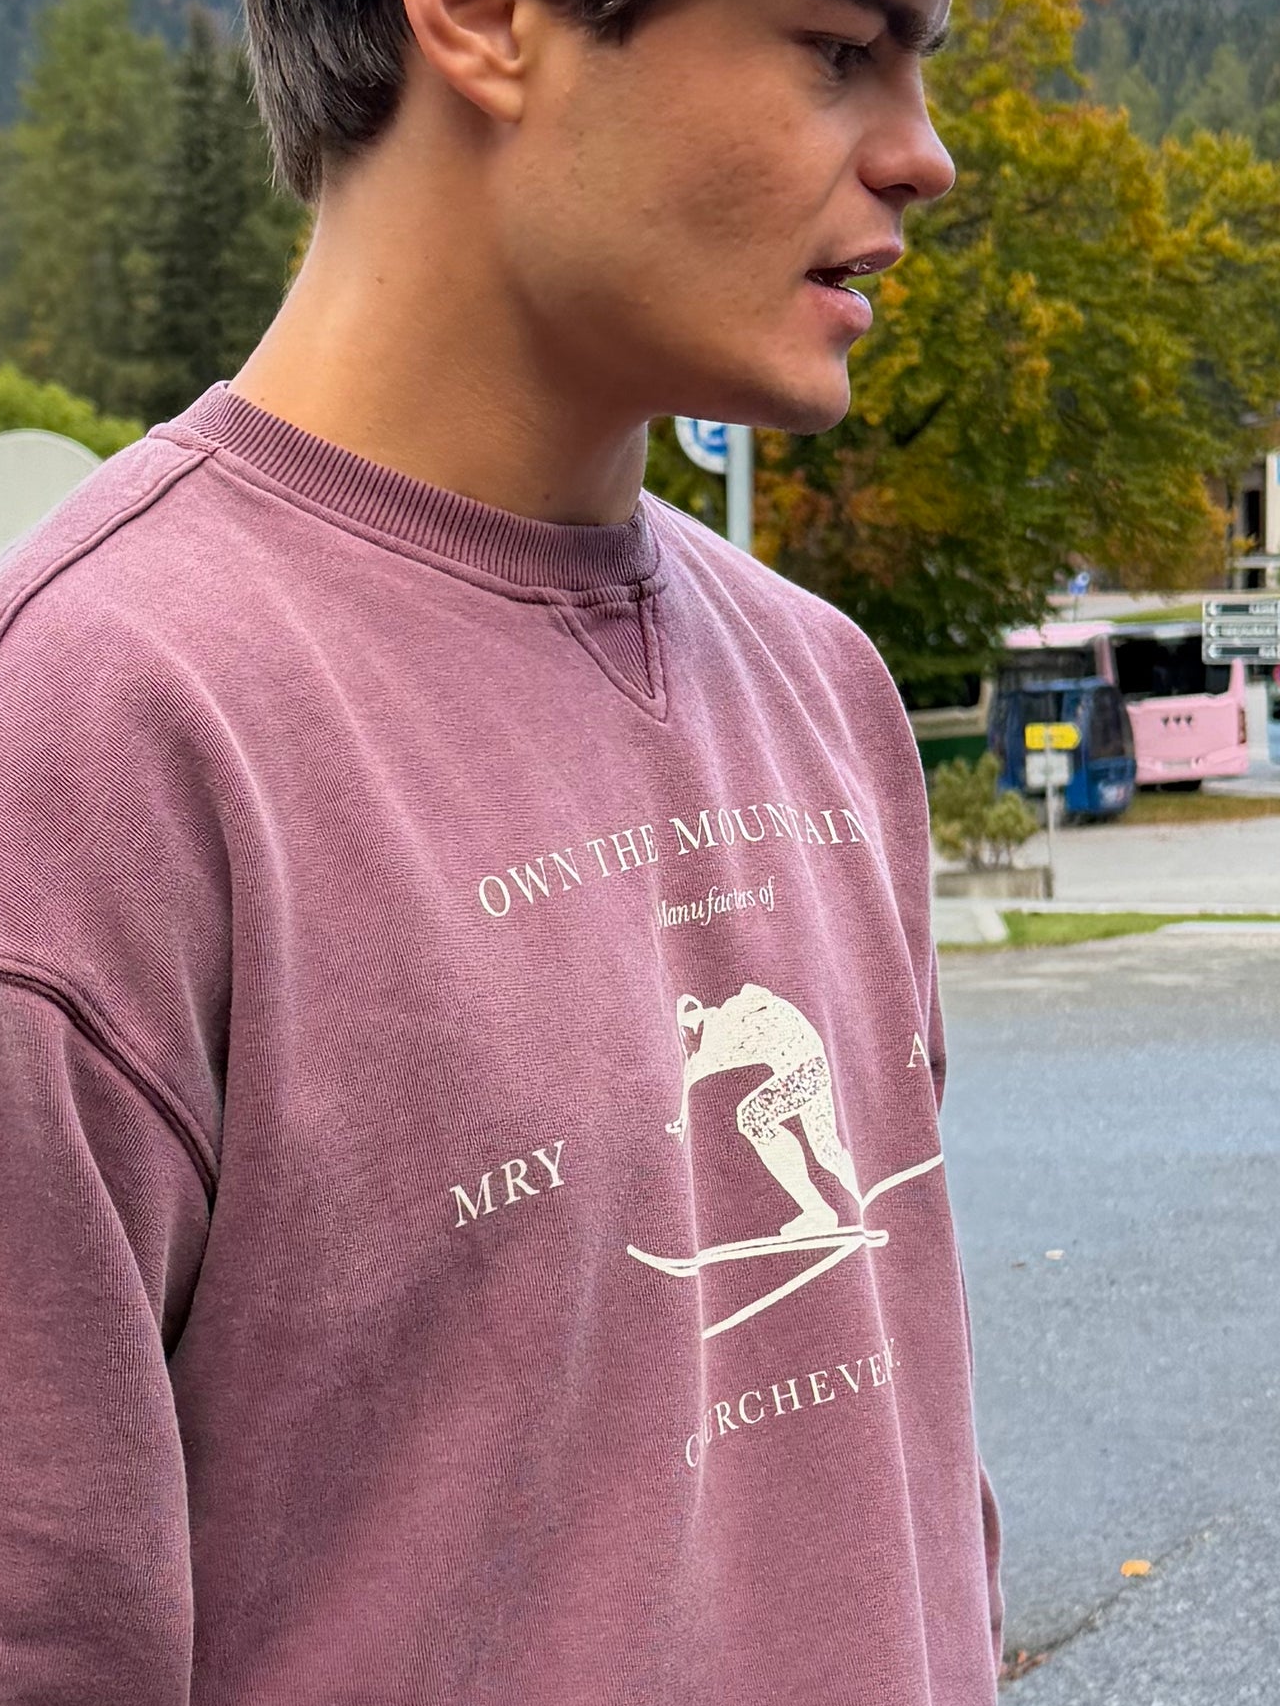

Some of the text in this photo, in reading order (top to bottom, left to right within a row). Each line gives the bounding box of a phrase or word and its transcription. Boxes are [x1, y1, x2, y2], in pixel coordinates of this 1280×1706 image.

[478, 803, 870, 918] OWN THE MOUNTAIN
[758, 875, 776, 912] of
[450, 1140, 565, 1228] MRY
